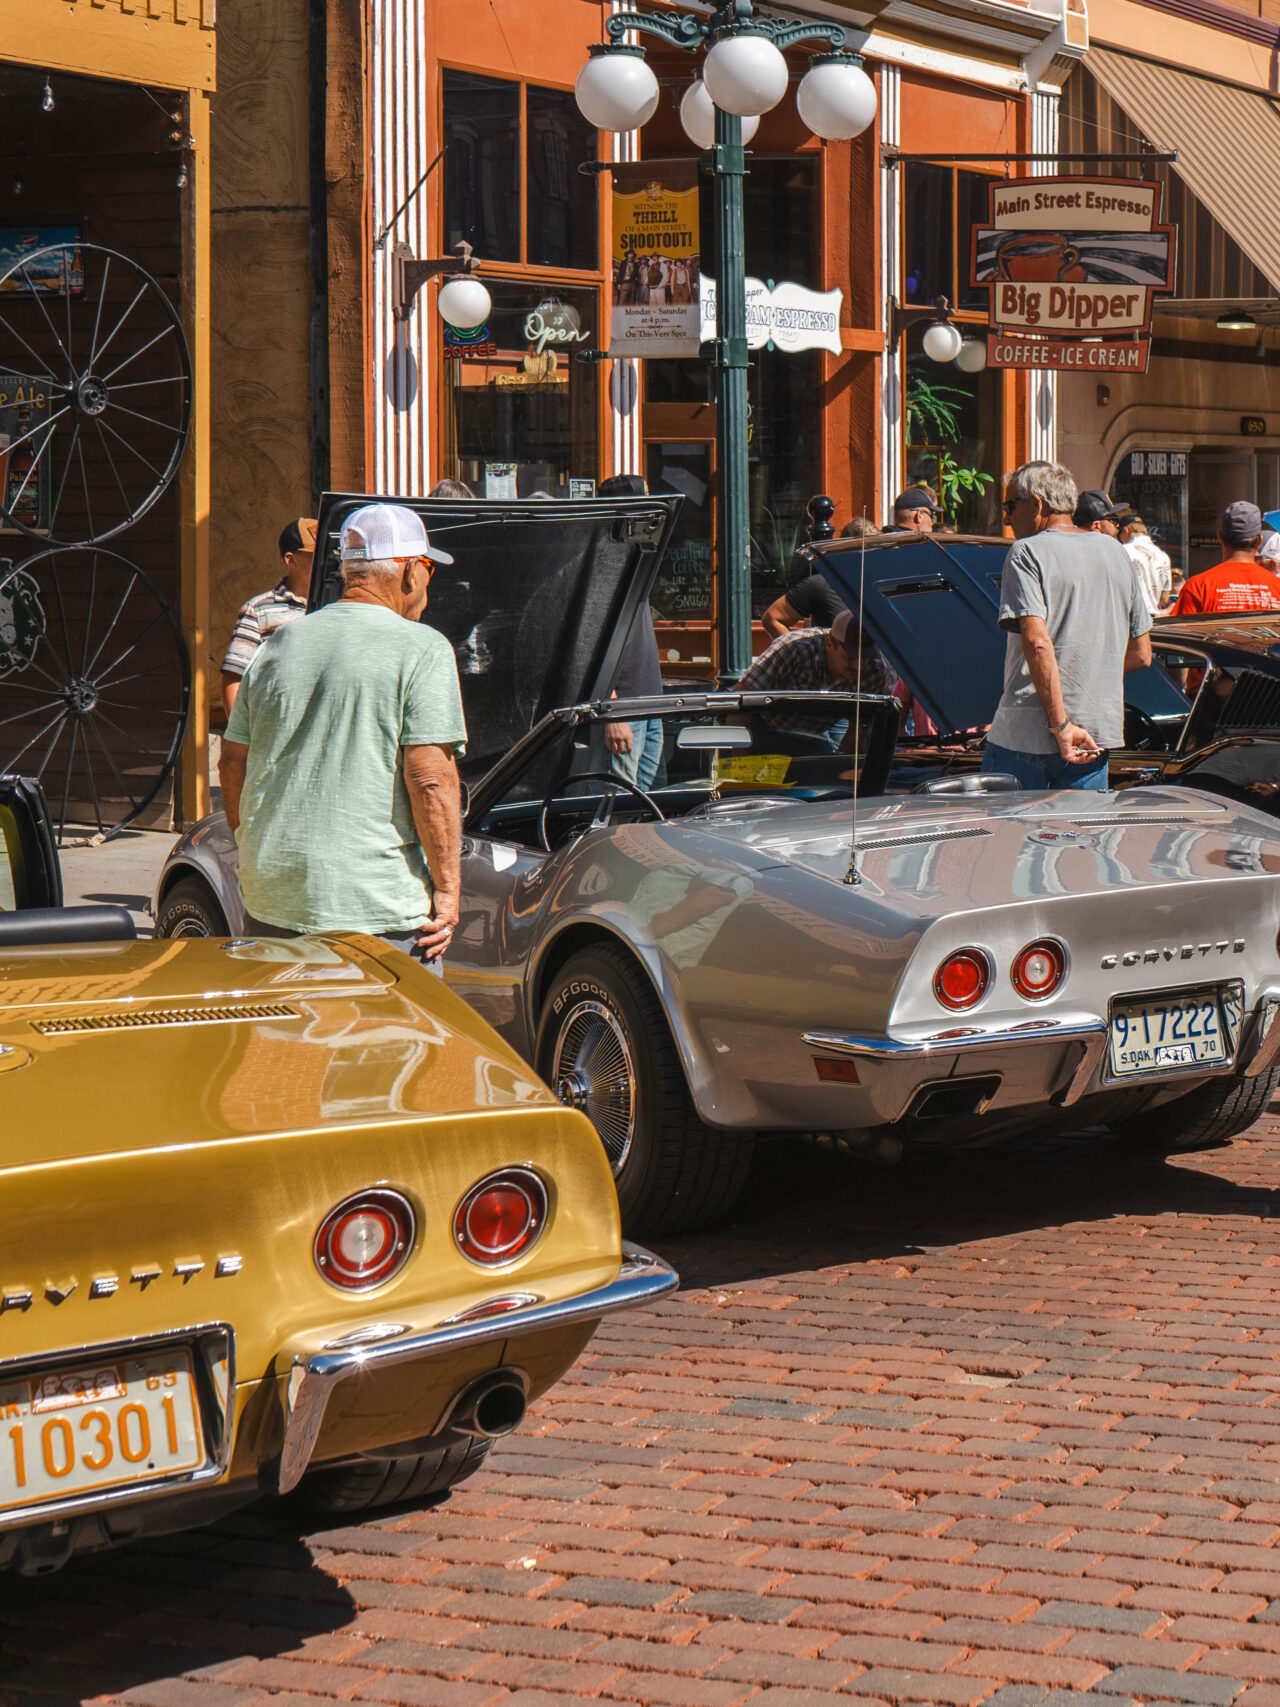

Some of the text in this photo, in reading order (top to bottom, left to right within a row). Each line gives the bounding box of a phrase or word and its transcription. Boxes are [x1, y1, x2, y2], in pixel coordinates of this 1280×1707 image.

[996, 191, 1151, 217] Main Street Espresso
[633, 210, 678, 224] THRILL
[620, 232, 692, 249] SHOOTOUT!
[625, 308, 651, 316] Monday
[701, 299, 837, 332] IC EAM ESPRESSO
[1001, 284, 1140, 328] Big Dipper
[524, 312, 591, 354] Open
[654, 330, 670, 338] Very
[671, 330, 687, 338] Spot
[443, 343, 497, 358] COFFEE
[994, 345, 1140, 367] COFFEE ICE CREAM
[14, 386, 47, 409] Ale
[1148, 453, 1168, 475] SILVER
[1171, 453, 1187, 476] GIFTS
[1100, 938, 1246, 970] CORVETTE
[1114, 1001, 1218, 1048] 9-17222
[1202, 1039, 1217, 1053] 70
[146, 1368, 177, 1390] 69
[9, 1391, 178, 1487] 10301
